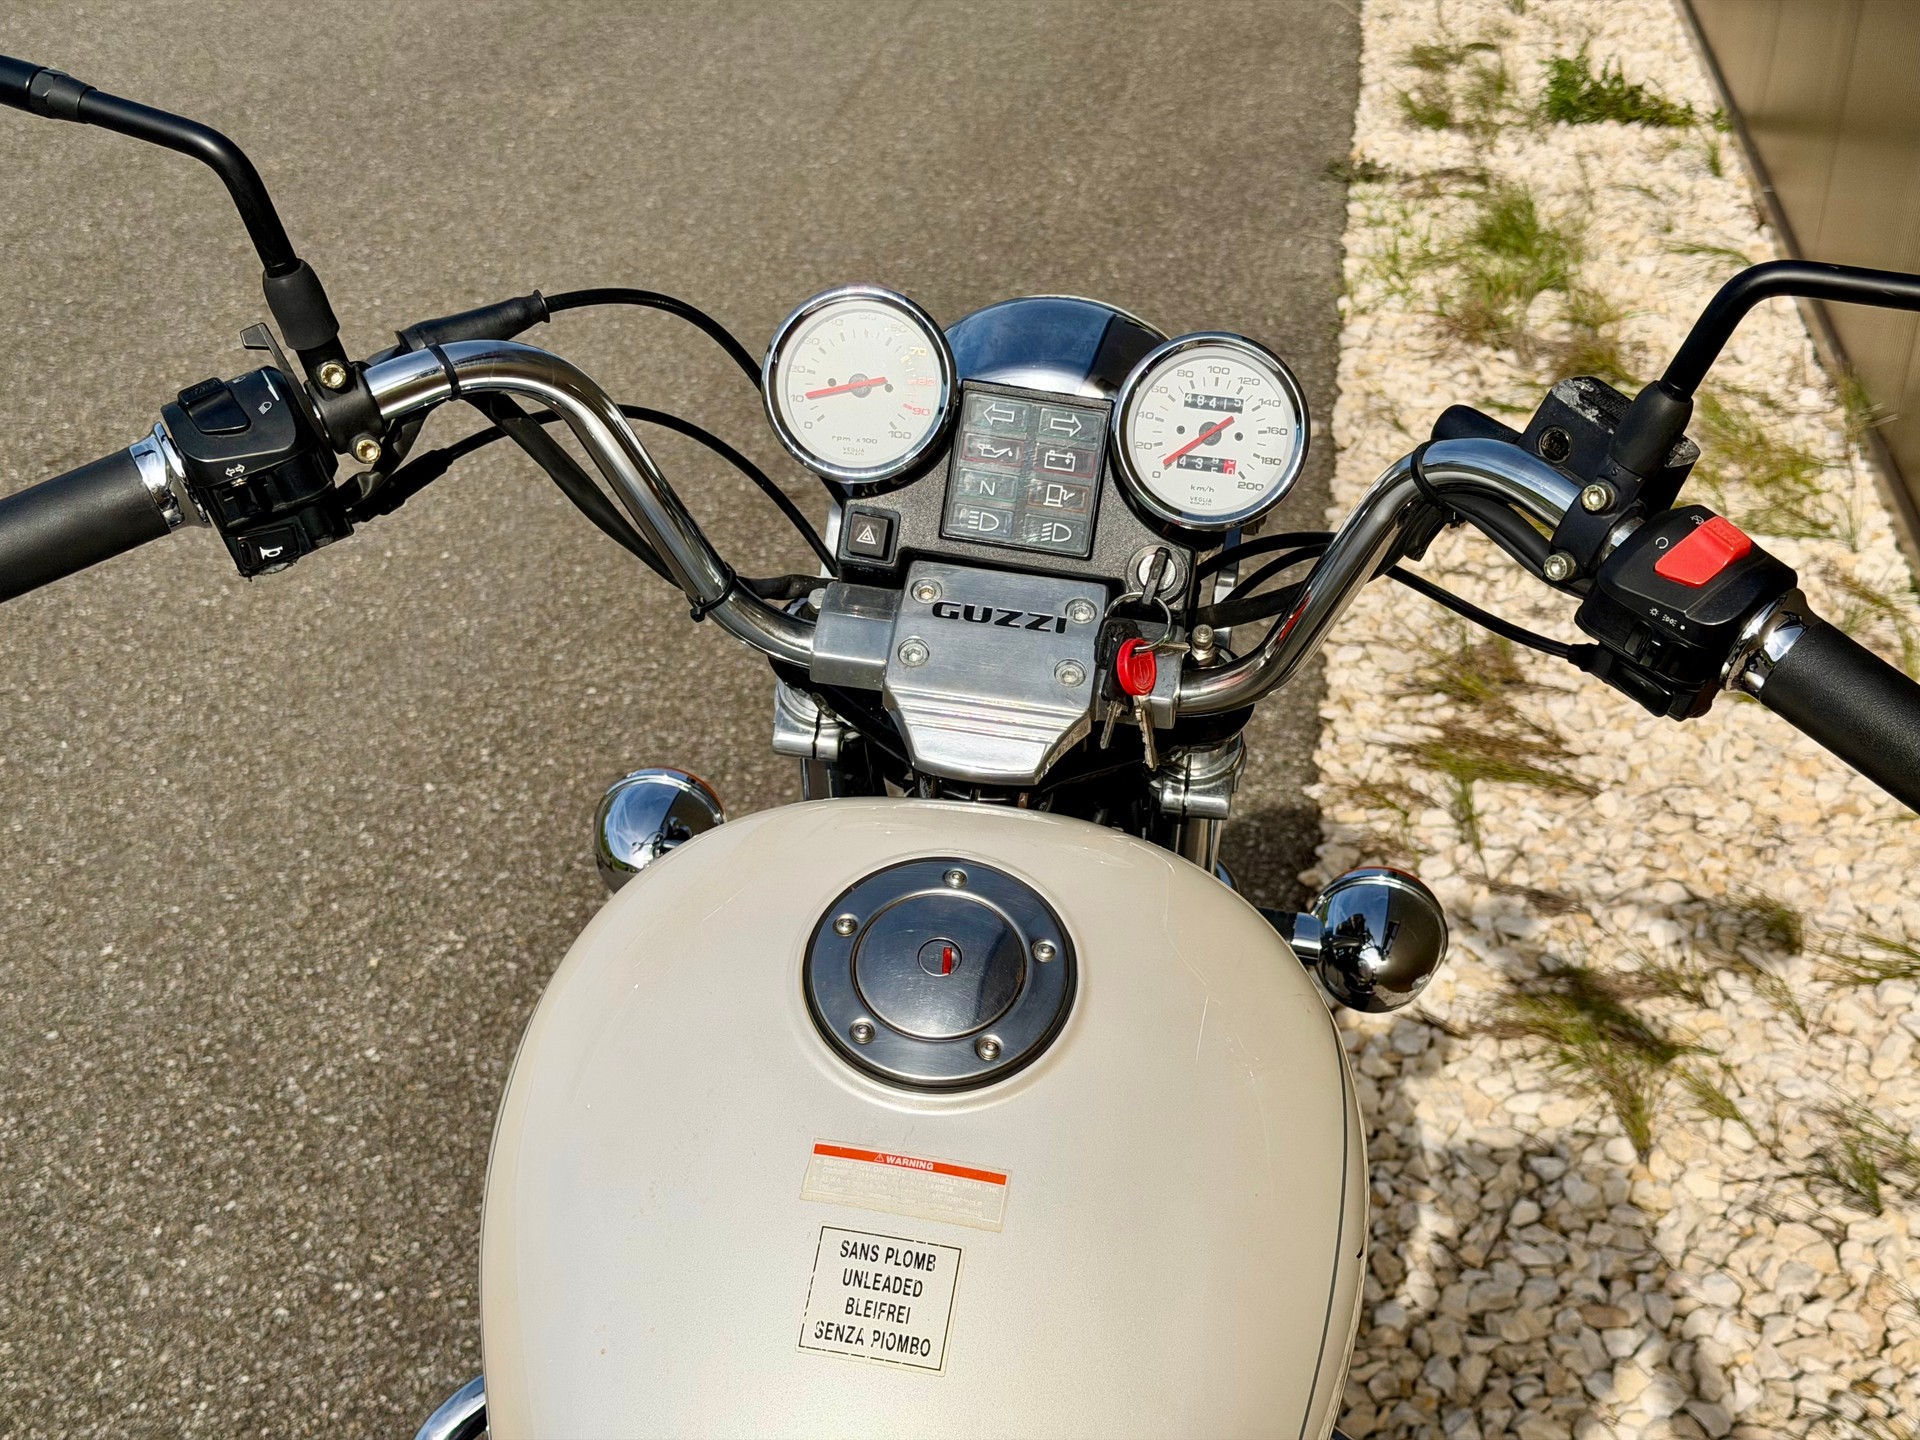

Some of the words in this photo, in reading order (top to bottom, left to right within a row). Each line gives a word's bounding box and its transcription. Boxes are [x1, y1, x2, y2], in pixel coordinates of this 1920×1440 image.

[790, 364, 806, 373] 20
[1207, 366, 1230, 375] 100
[1176, 369, 1194, 379] 80
[1238, 377, 1261, 386] 120
[1150, 386, 1168, 395] 60
[790, 394, 805, 403] 10
[1258, 398, 1281, 408] 140
[912, 407, 931, 416] 90
[1138, 411, 1155, 420] 40
[804, 421, 813, 430] 0
[888, 430, 912, 440] 100
[1266, 426, 1288, 436] 160
[831, 435, 851, 443] rpm
[1135, 441, 1153, 450] 20
[1260, 456, 1282, 466] 180
[1152, 471, 1161, 479] 0
[979, 480, 996, 496] N
[1190, 484, 1215, 493] km/h
[1237, 481, 1264, 491] 200
[1190, 495, 1212, 503] VEGLIA
[932, 601, 1067, 634] GUZZI
[886, 1155, 934, 1171] WARNING
[840, 1239, 880, 1262] SANS
[884, 1247, 937, 1272] PLOMB
[842, 1268, 923, 1298] UNLEADED
[845, 1297, 911, 1325] BLEIFREI
[814, 1320, 864, 1346] SENZA
[871, 1329, 931, 1358] PIOMBO
